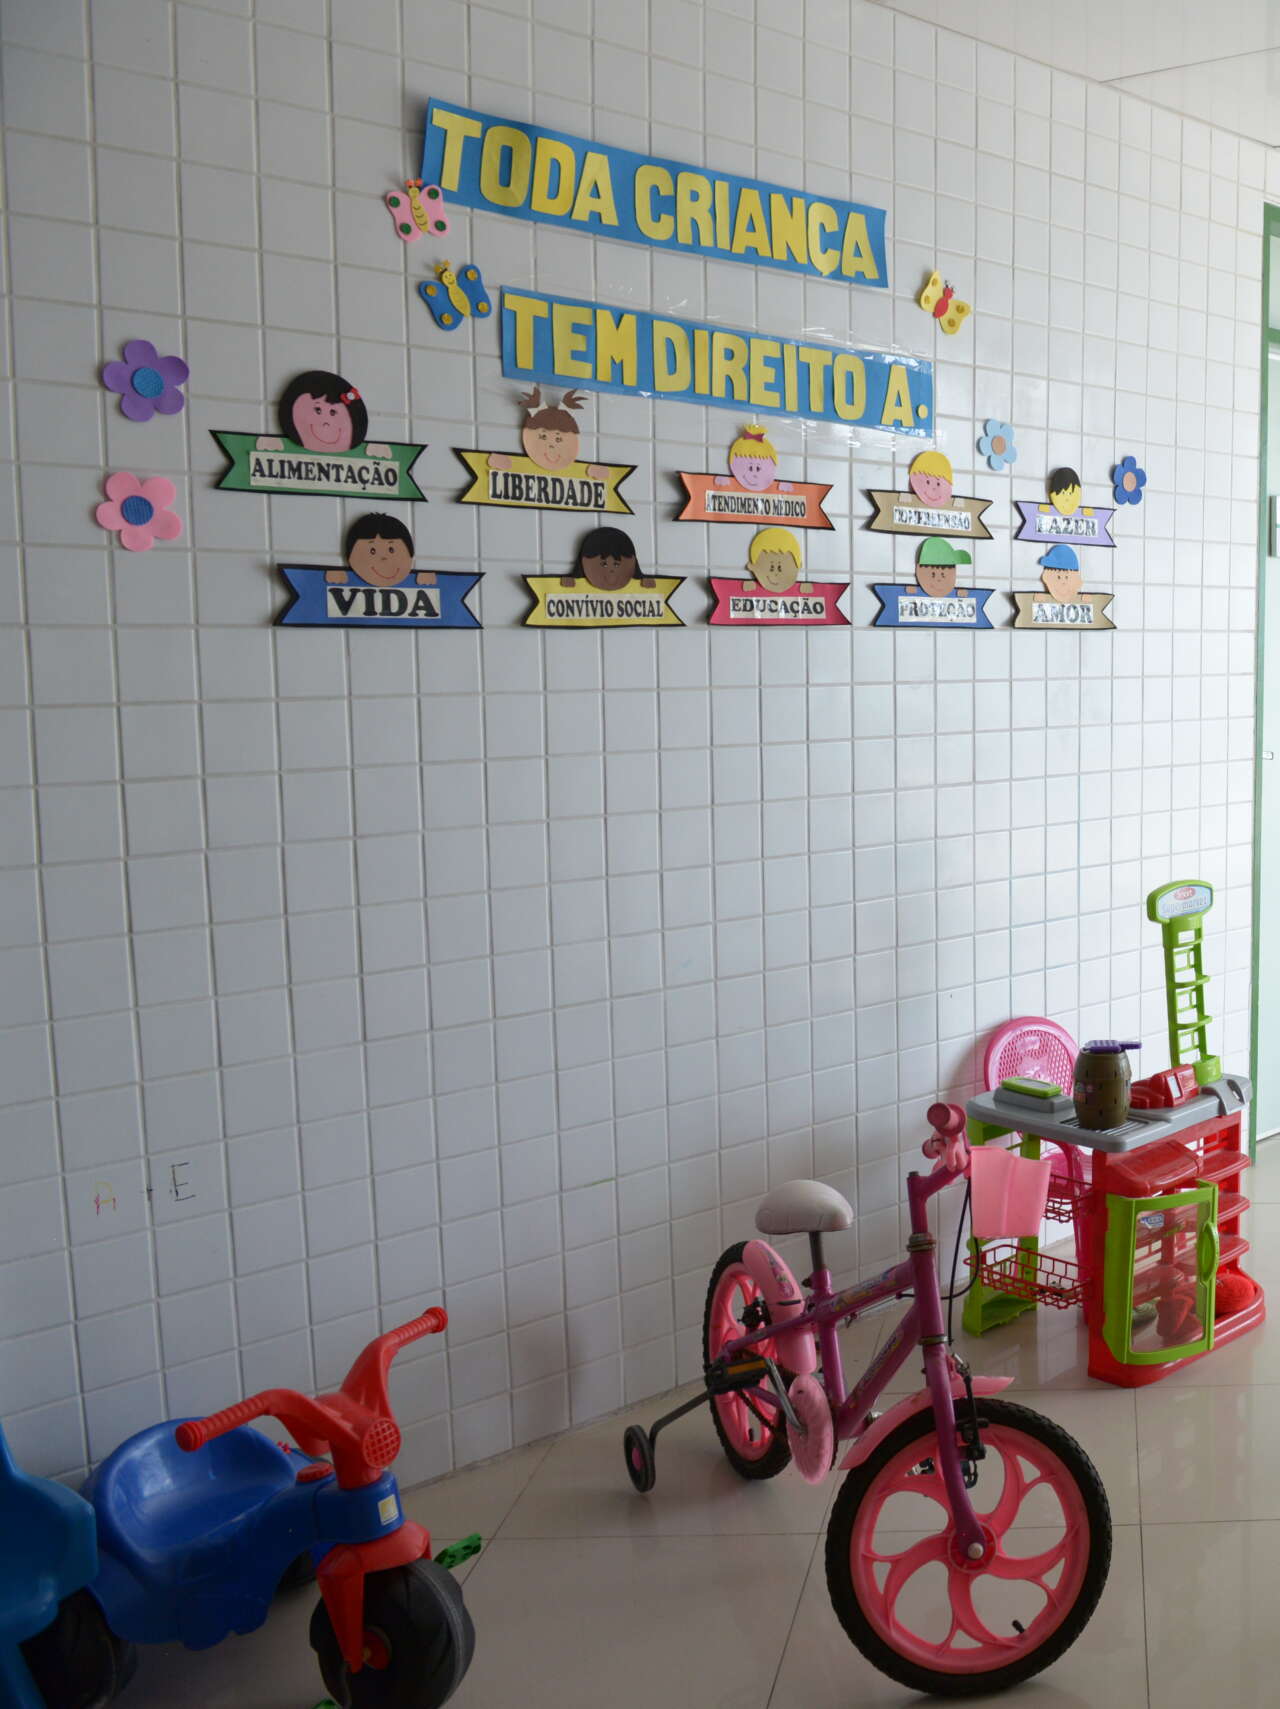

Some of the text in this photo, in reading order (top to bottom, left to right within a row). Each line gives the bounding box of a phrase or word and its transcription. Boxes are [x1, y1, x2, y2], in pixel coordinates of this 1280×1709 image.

[431, 107, 880, 280] TODA CRIANÇA
[504, 293, 638, 388] TEM
[652, 319, 866, 421] DIREITO
[251, 457, 399, 490] ALIMENTAÇÃO
[491, 471, 605, 508] LIBERDADE
[328, 588, 439, 617] VIDA
[547, 594, 663, 618] CONVÍVIO SOCIAL
[731, 598, 825, 618] EDUCAÇÃO
[1033, 604, 1093, 624] AMOR
